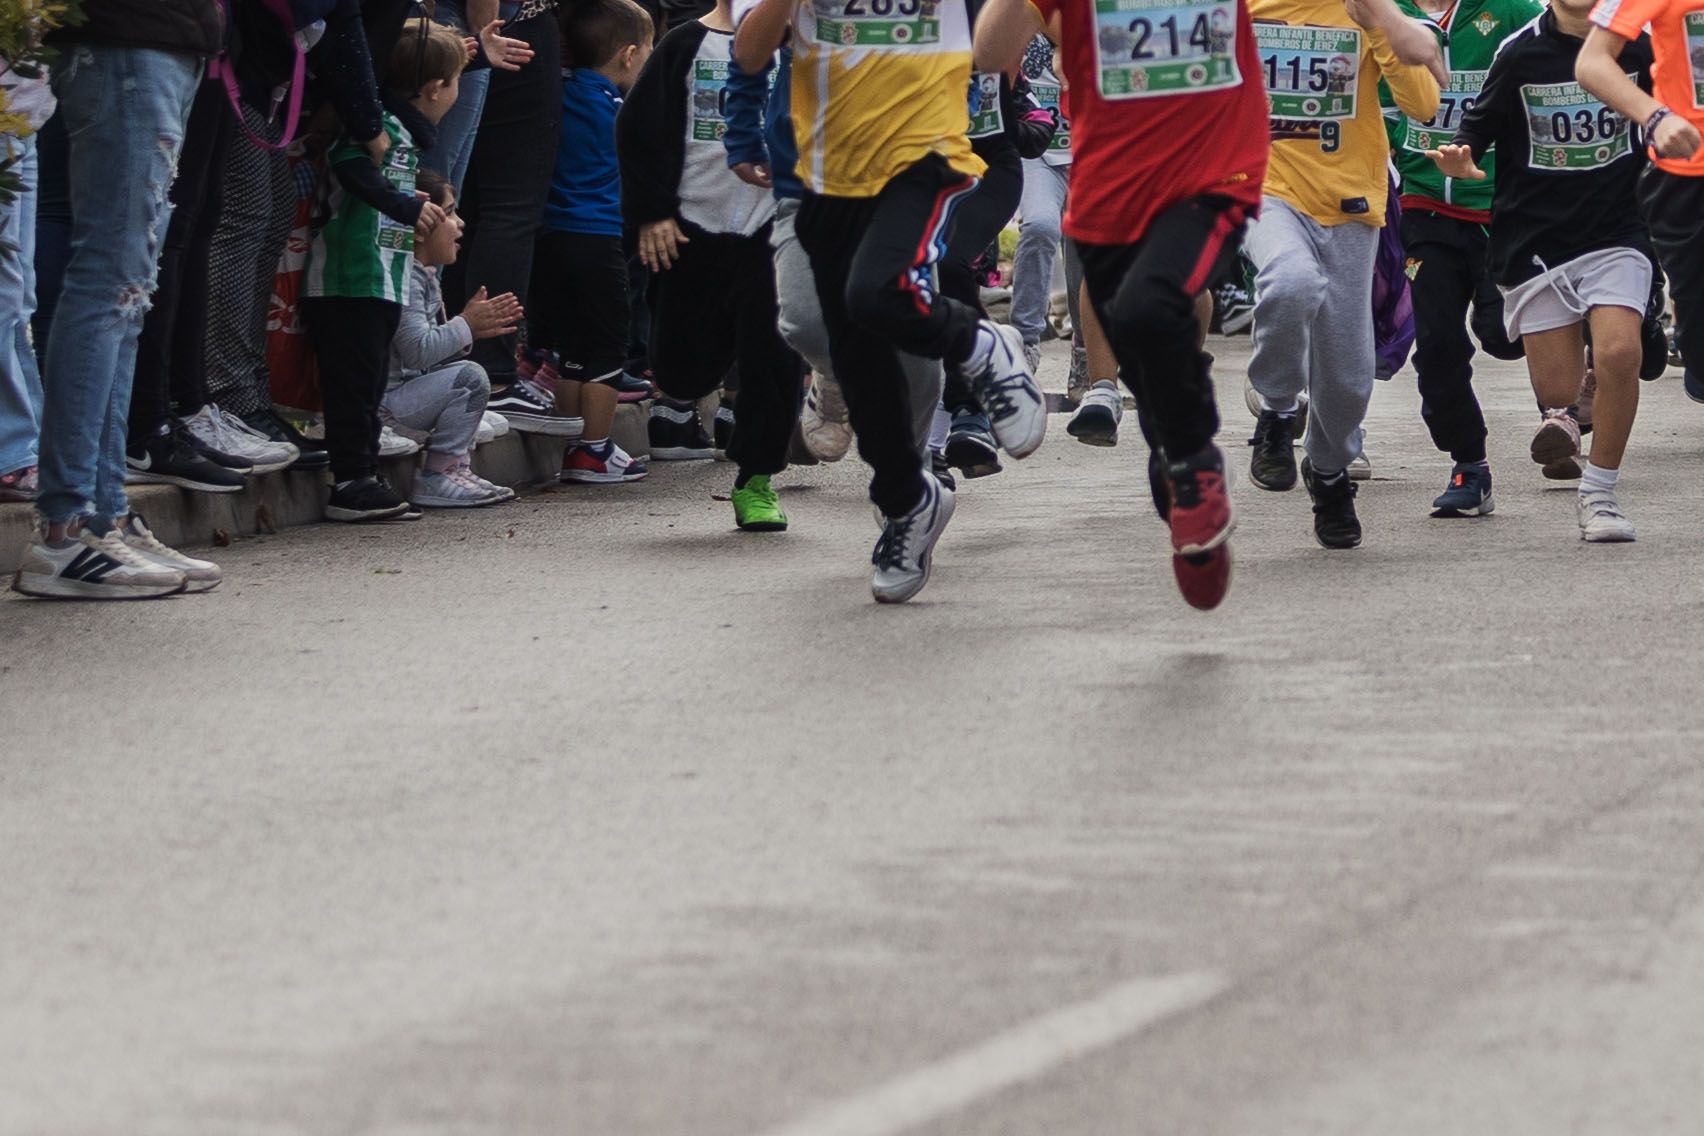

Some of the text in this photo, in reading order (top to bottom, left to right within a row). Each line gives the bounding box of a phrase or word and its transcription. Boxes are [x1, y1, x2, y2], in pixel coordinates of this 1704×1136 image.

[1129, 13, 1211, 60] 214
[1314, 41, 1337, 51] JEREZ
[1263, 54, 1328, 92] 115
[1320, 120, 1341, 153] 9
[1552, 107, 1616, 143] 036
